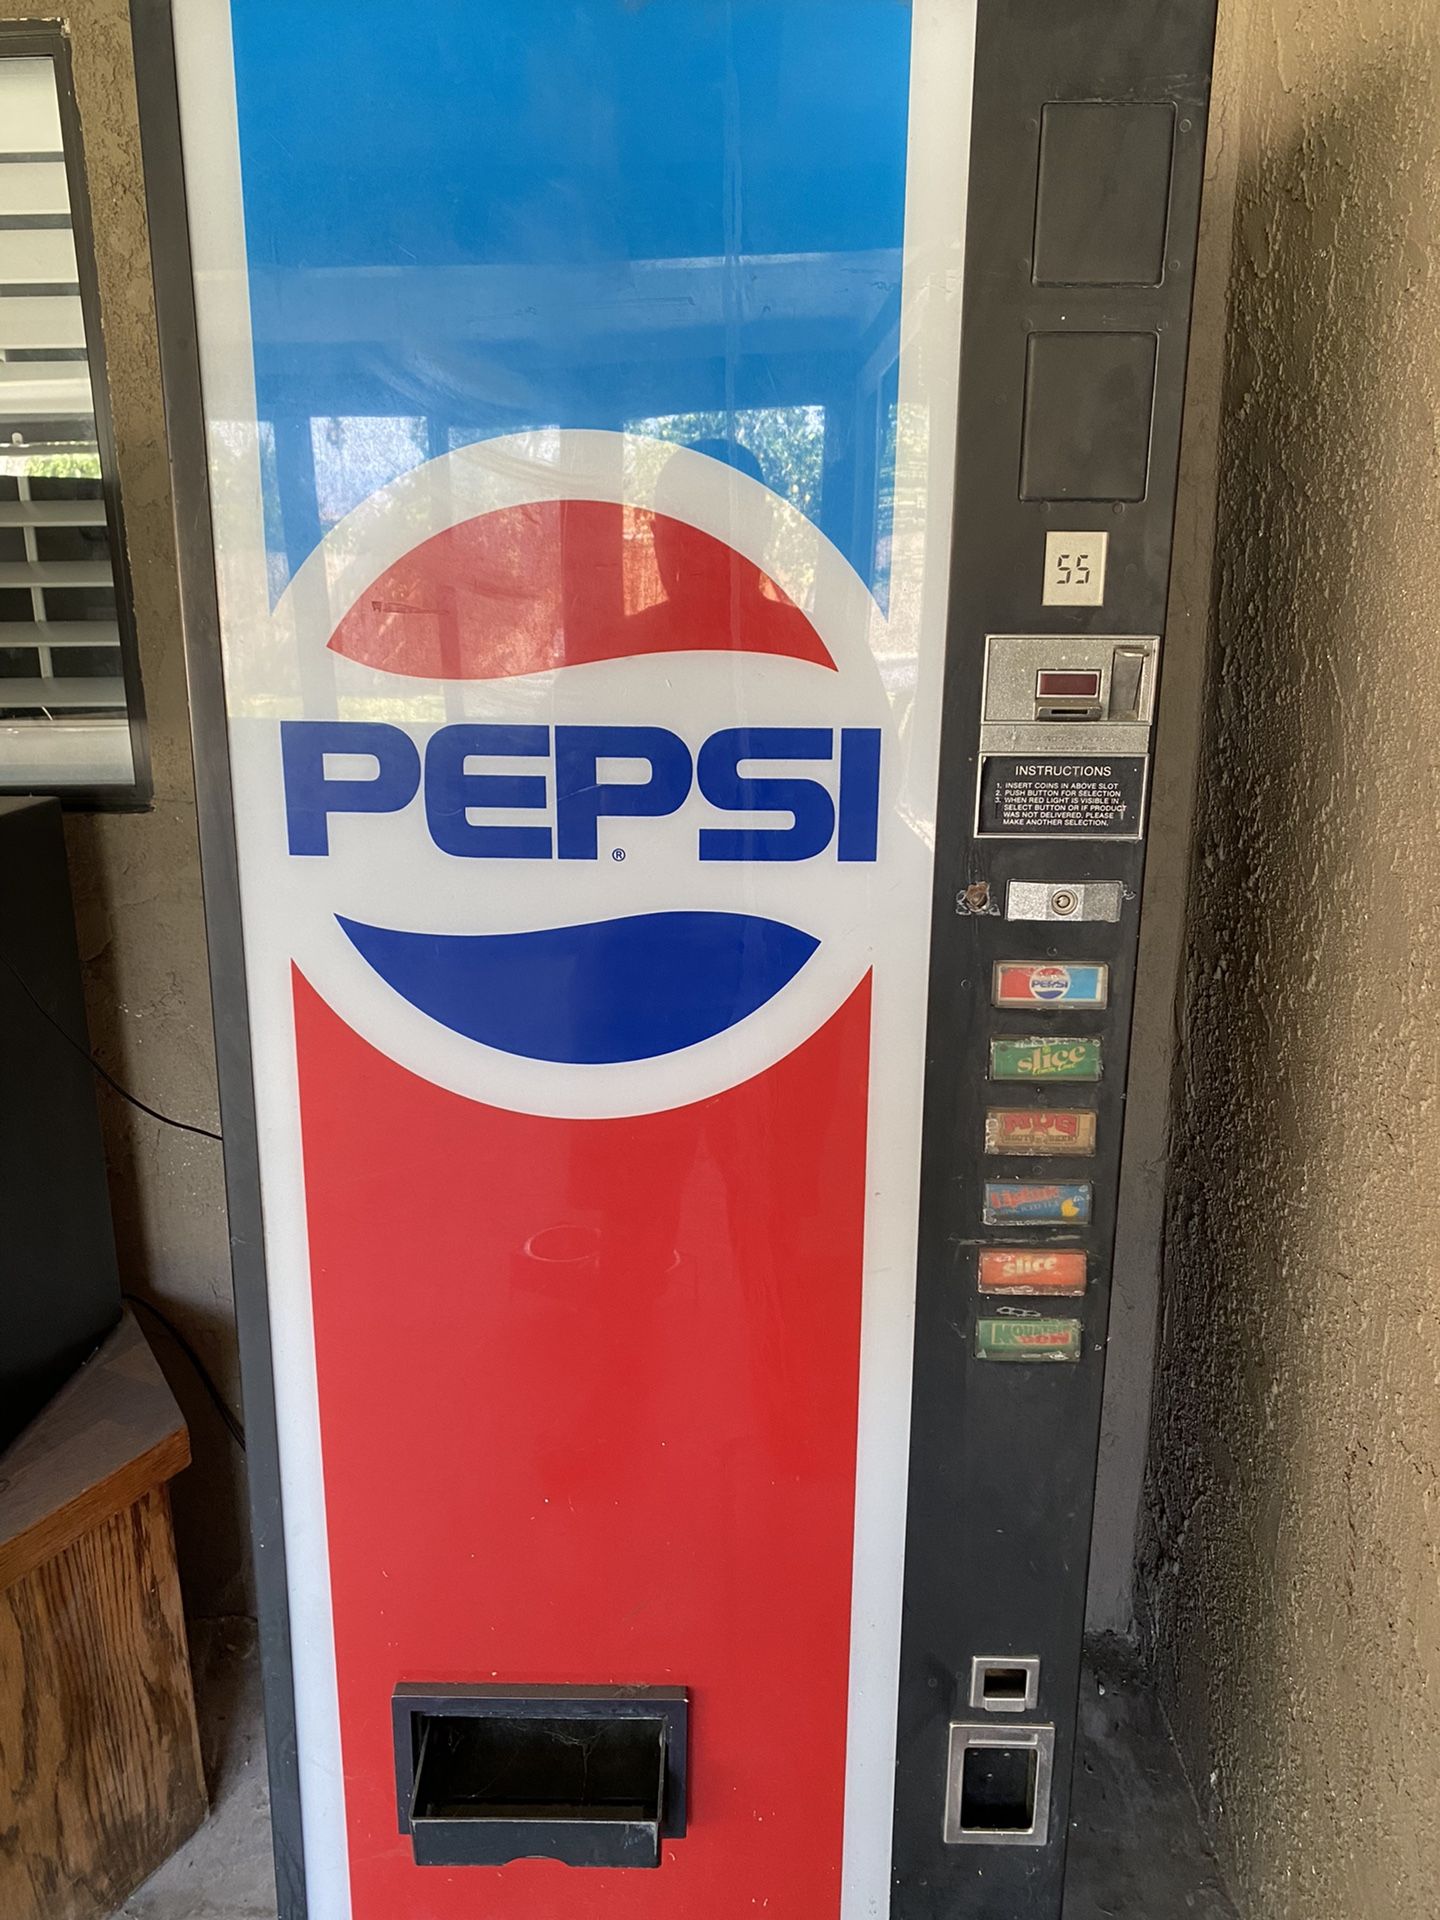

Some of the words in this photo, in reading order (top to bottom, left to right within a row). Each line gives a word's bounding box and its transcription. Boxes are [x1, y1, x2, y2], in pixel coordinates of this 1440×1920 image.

[1056, 554, 1090, 585] 55
[1015, 765, 1112, 777] INSTRUCTIONS
[1004, 782, 1033, 790] INSERT
[1034, 782, 1059, 790] COINS
[1070, 782, 1097, 790] ABOVE
[280, 720, 882, 862] PEPSI
[1004, 789, 1026, 797] PUSH
[1027, 789, 1059, 797] BUTTON
[1078, 790, 1121, 798] SELECTION
[1004, 796, 1027, 804] WHEN
[1003, 803, 1033, 811] SELECT
[1090, 804, 1127, 812] PRODUCT
[1085, 811, 1115, 819] PLEASE
[1025, 818, 1063, 826] ANOTHER
[1031, 979, 1069, 989] PEPSI
[1017, 1045, 1086, 1073] slice
[1002, 1254, 1057, 1277] slice
